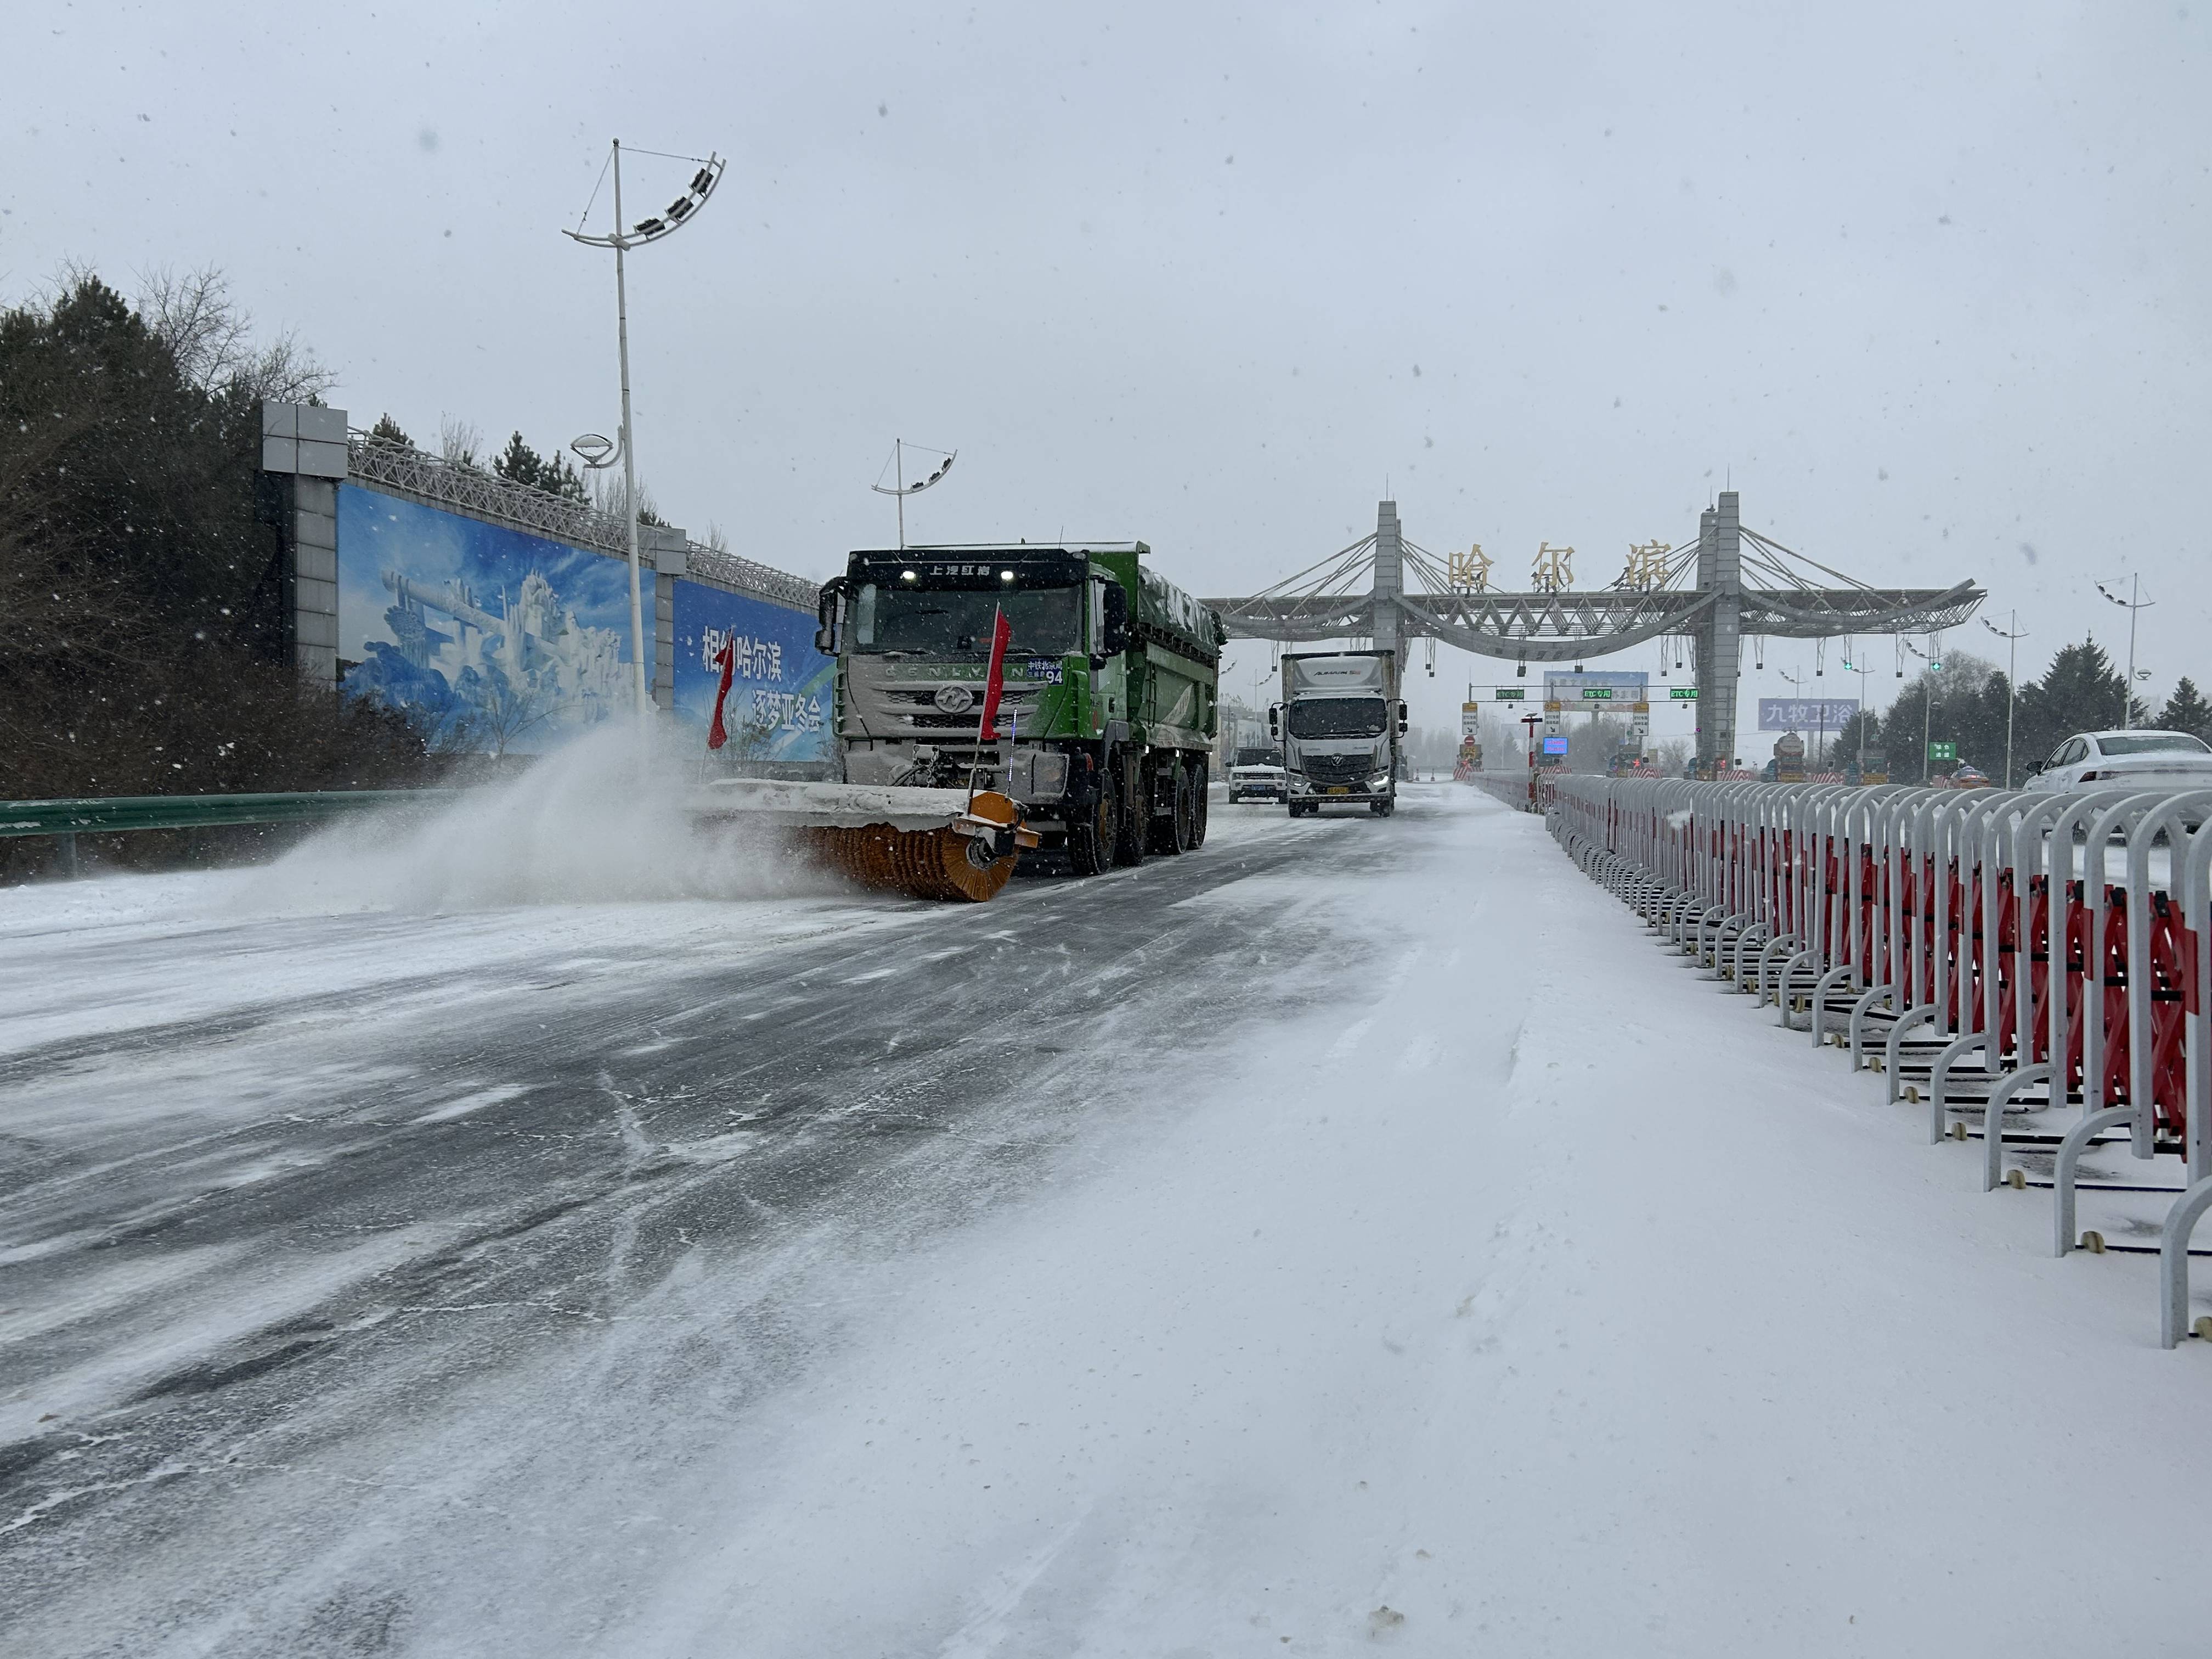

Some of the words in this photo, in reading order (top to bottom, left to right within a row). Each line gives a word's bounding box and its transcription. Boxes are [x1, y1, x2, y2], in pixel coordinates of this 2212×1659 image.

[929, 565, 990, 575] 上汽红岩
[1448, 539, 1671, 589] 哈尔滨
[885, 664, 1023, 678] GENLYN
[1046, 670, 1063, 684] 94
[1671, 689, 1698, 698] ETC专用
[752, 689, 821, 732] 逐梦亚冬会
[1766, 704, 1853, 723] 九牧卫浴
